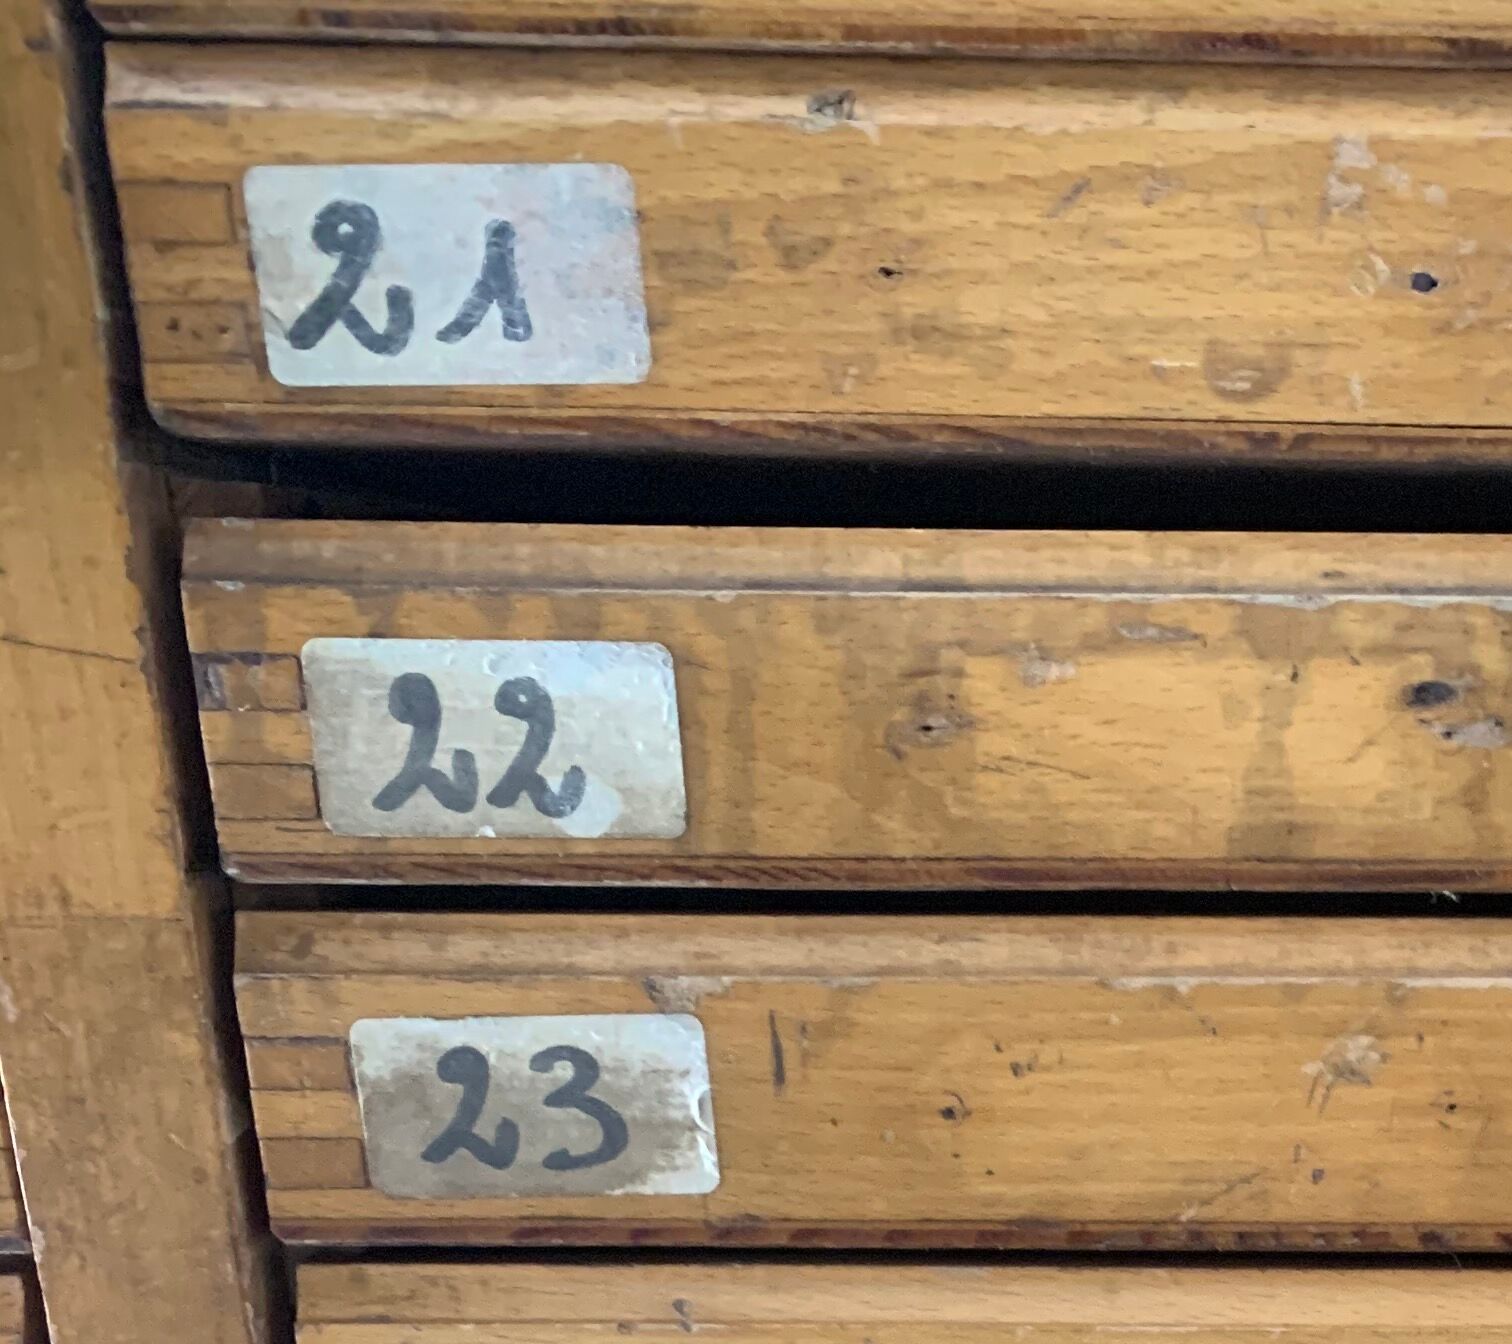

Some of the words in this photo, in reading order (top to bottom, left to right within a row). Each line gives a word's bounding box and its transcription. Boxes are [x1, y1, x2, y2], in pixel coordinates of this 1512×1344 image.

[288, 200, 533, 356] 21
[372, 672, 587, 818] 22
[420, 1044, 630, 1171] 23
